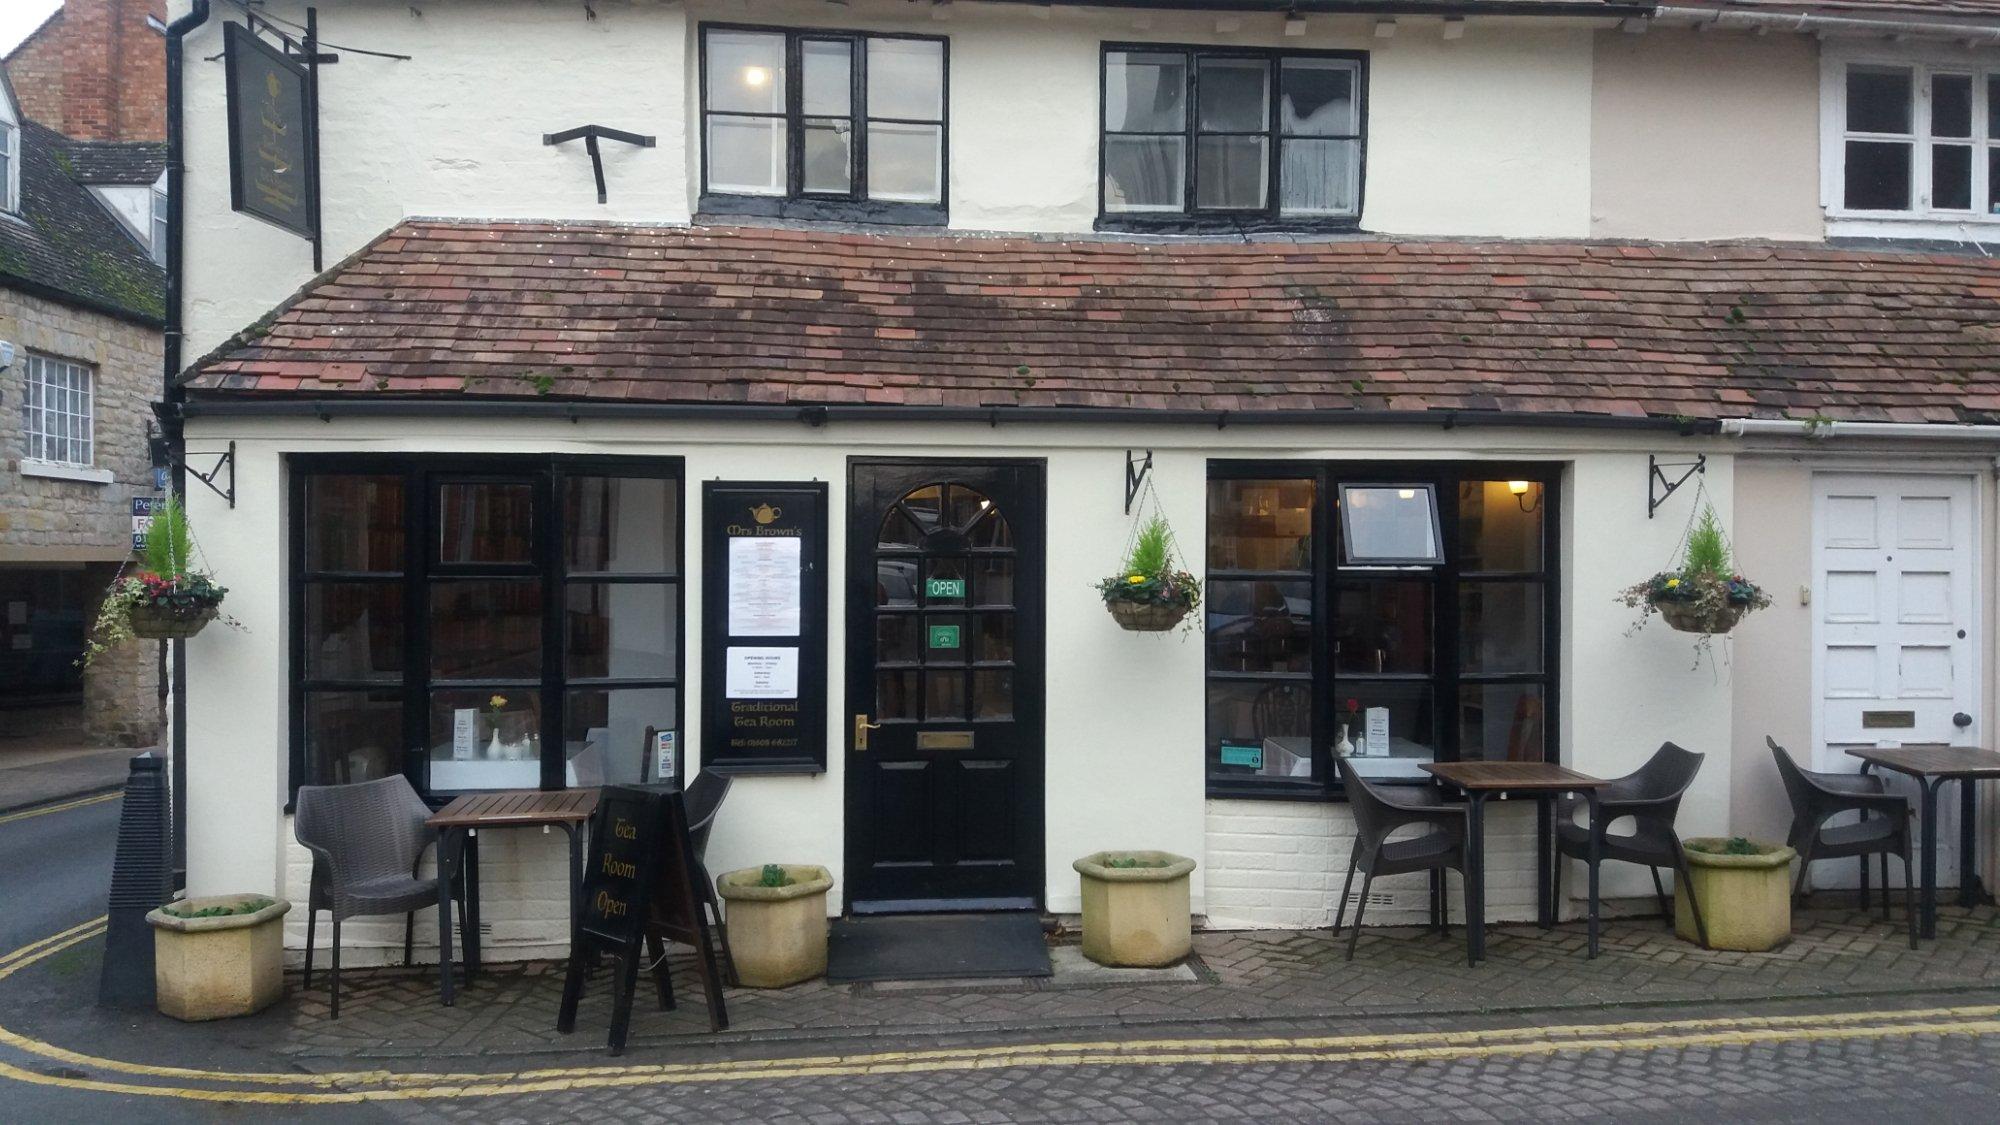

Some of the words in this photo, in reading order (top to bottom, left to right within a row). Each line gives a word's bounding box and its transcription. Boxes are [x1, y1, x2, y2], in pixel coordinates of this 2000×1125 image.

[727, 524, 752, 536] Mrs
[755, 525, 802, 536] Brown's
[932, 581, 960, 595] OPEN
[731, 701, 799, 712] Traditional
[734, 716, 757, 727] Tea
[760, 716, 795, 727] Room
[615, 818, 636, 840] Tea
[602, 852, 636, 879] Room
[597, 891, 627, 919] Open
